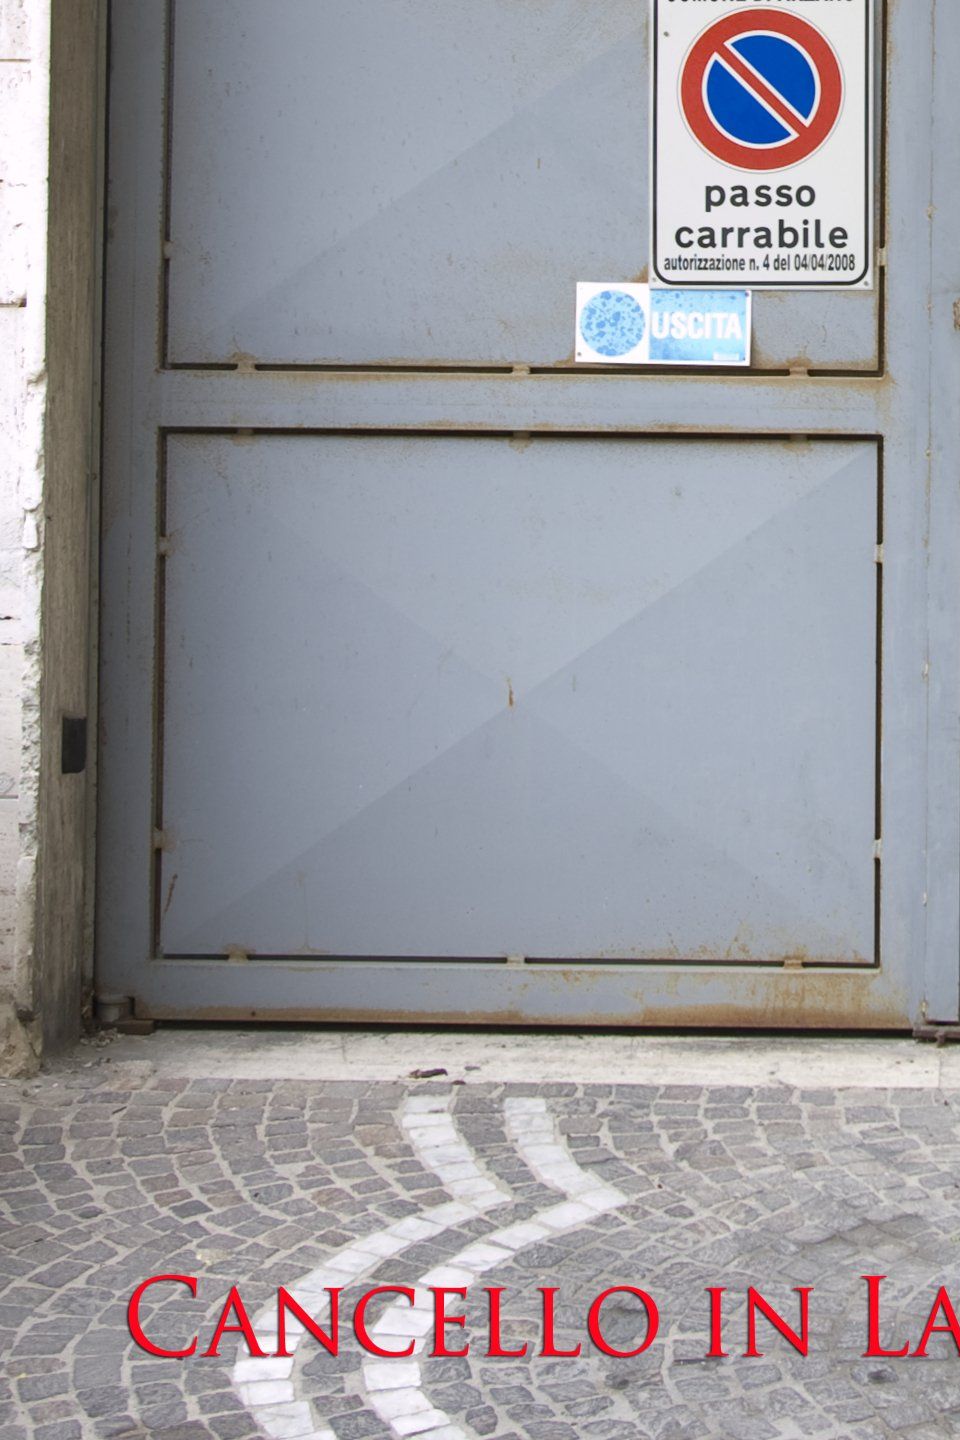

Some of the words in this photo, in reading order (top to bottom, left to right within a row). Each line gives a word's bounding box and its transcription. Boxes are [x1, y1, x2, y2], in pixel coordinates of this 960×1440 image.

[704, 184, 816, 212] passo
[674, 219, 849, 249] carrabile
[664, 254, 745, 271] autorizzazione
[749, 257, 760, 271] n.
[762, 256, 770, 271] 4
[773, 254, 791, 271] del
[794, 254, 856, 271] 04/04/2008
[651, 311, 743, 340] USCITA
